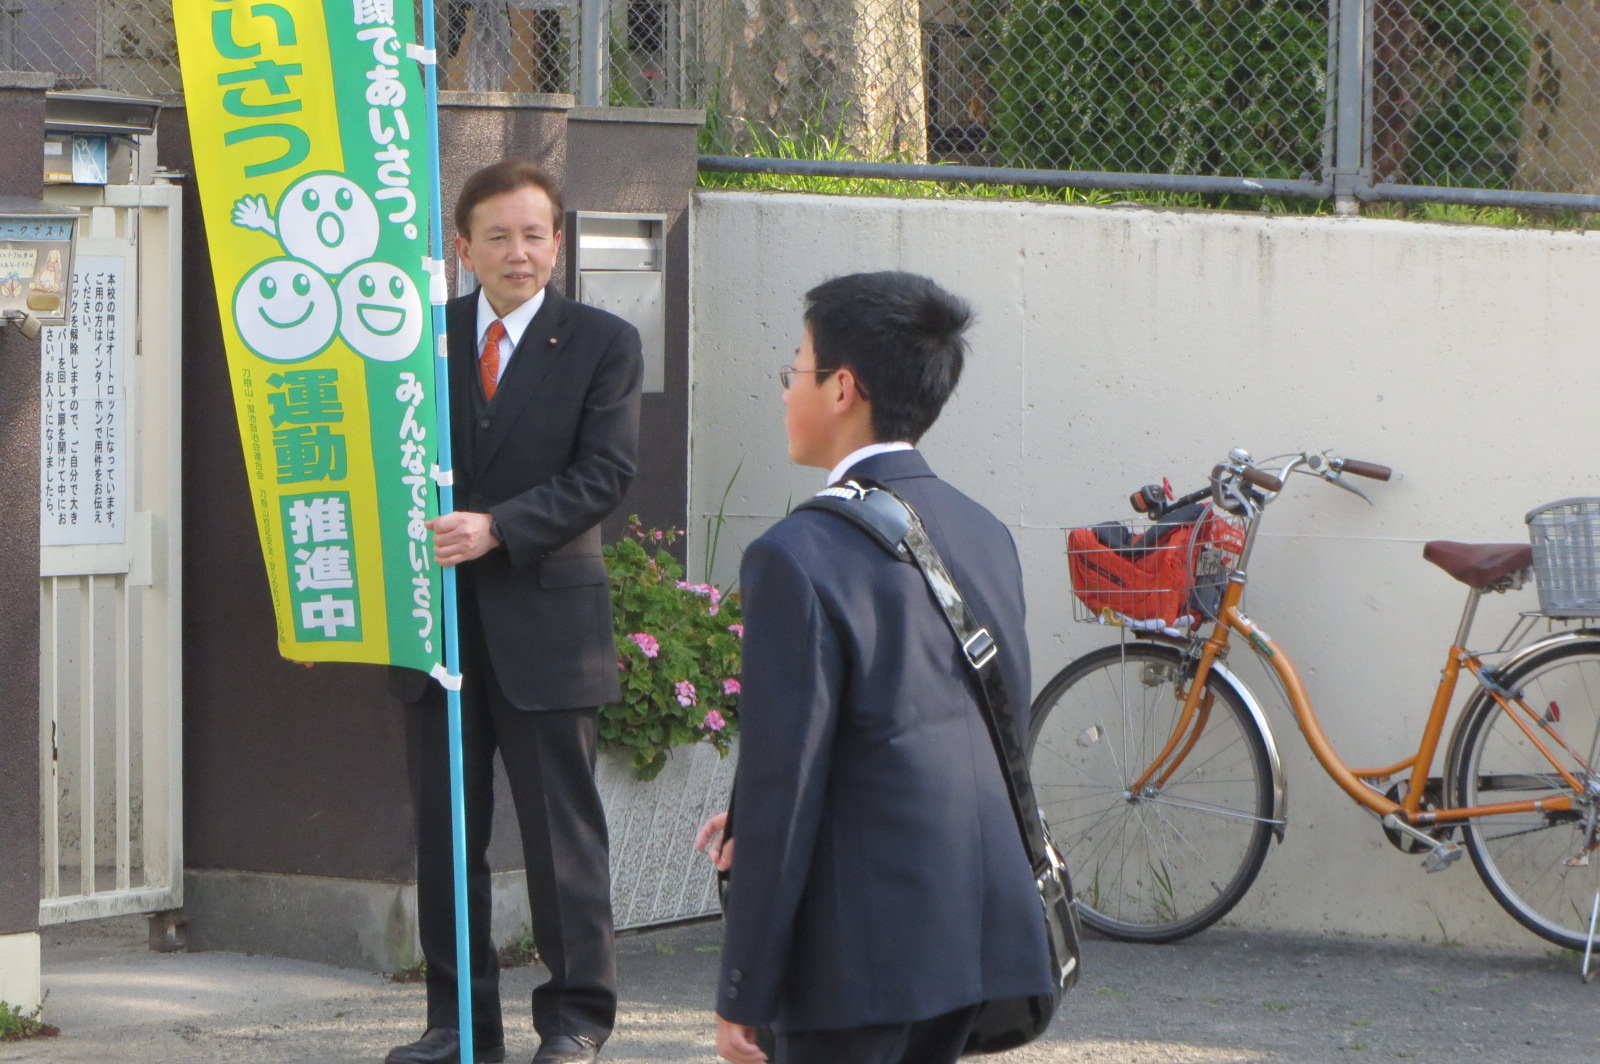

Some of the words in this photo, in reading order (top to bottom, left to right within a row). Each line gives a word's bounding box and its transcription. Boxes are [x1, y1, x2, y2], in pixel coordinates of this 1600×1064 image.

[211, 0, 310, 178] いさつ
[353, 0, 418, 240] 顔であいさつ。
[82, 272, 92, 333] ください。
[94, 272, 104, 523] ご用の方はインターホンで用件をお伝え
[106, 273, 115, 528] 本校の門はオートロックになっています。
[266, 369, 347, 484] 運動
[395, 372, 433, 653] みんなであいさつ。
[289, 497, 355, 637] 推進中
